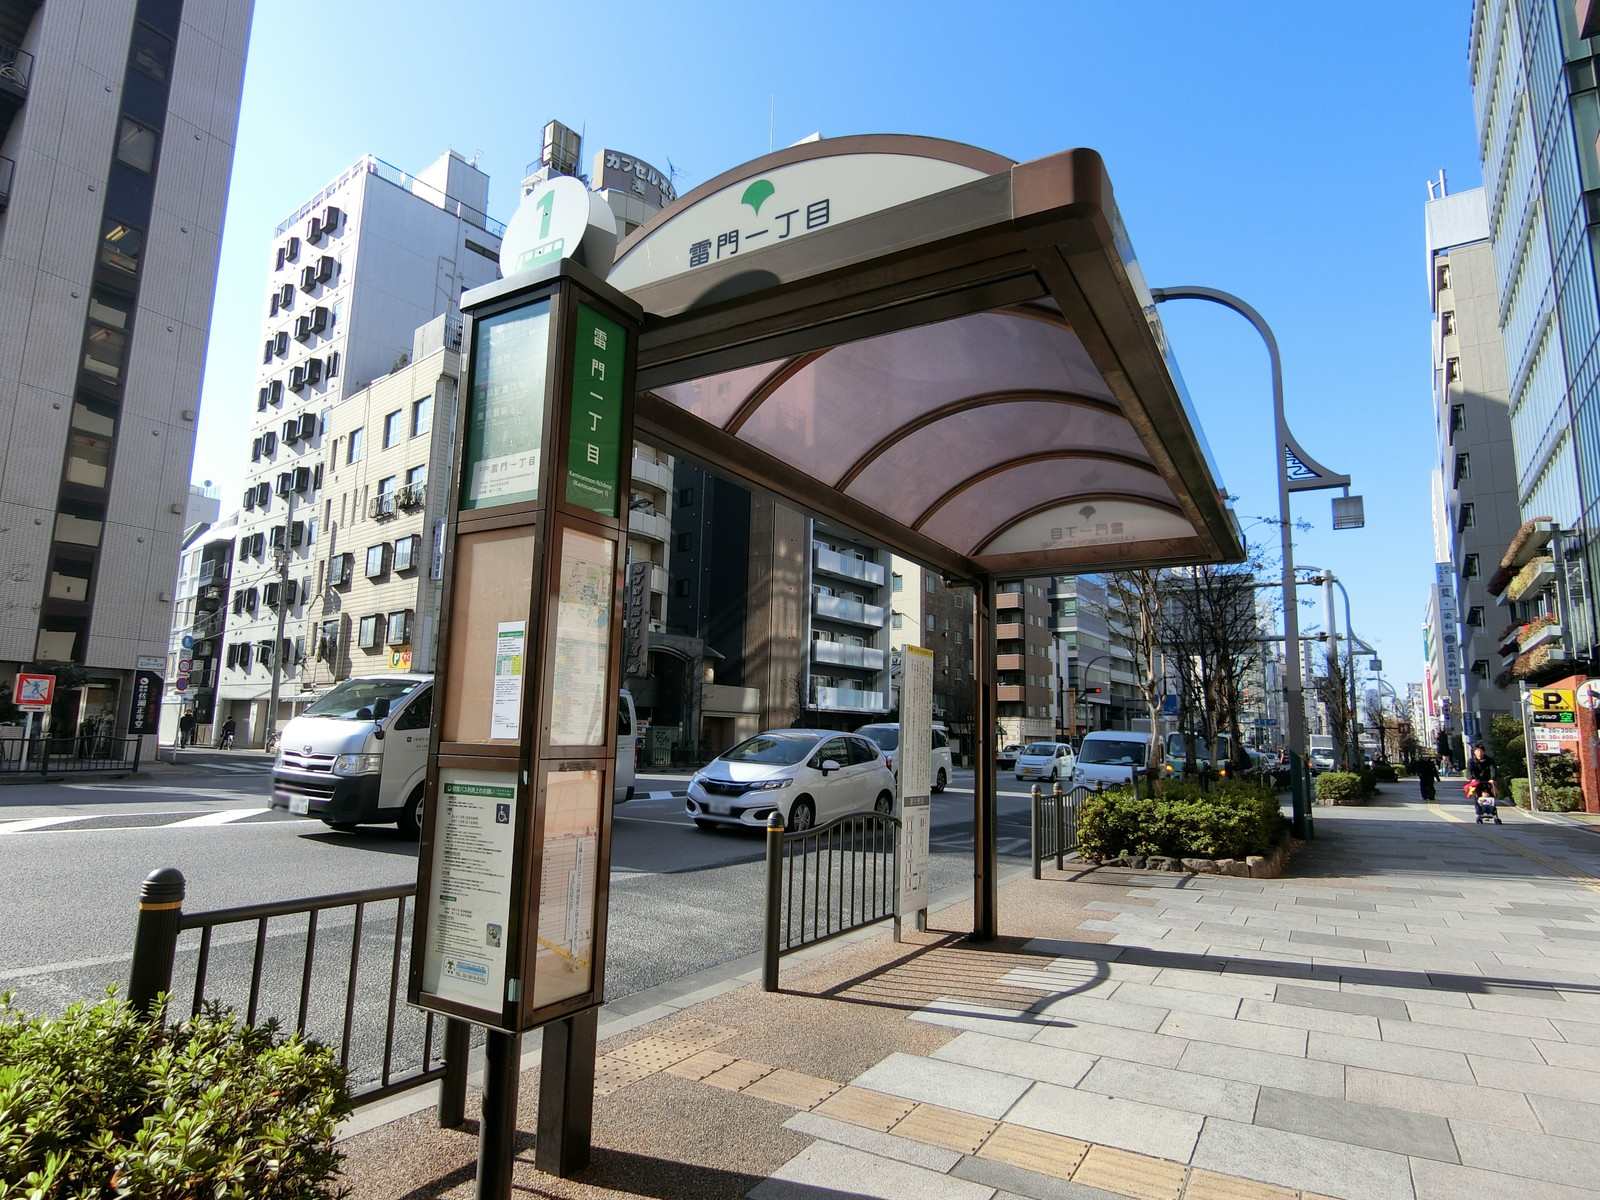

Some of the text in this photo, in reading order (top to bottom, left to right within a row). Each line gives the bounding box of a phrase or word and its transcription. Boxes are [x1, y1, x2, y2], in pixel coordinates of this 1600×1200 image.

[536, 189, 555, 240] 1
[689, 198, 830, 268] 雷門一丁目
[586, 327, 609, 466] 雷門一丁目
[491, 455, 536, 474] 雷門一丁目
[394, 653, 400, 665] P
[1543, 692, 1562, 710] P
[1559, 711, 1573, 723] 空
